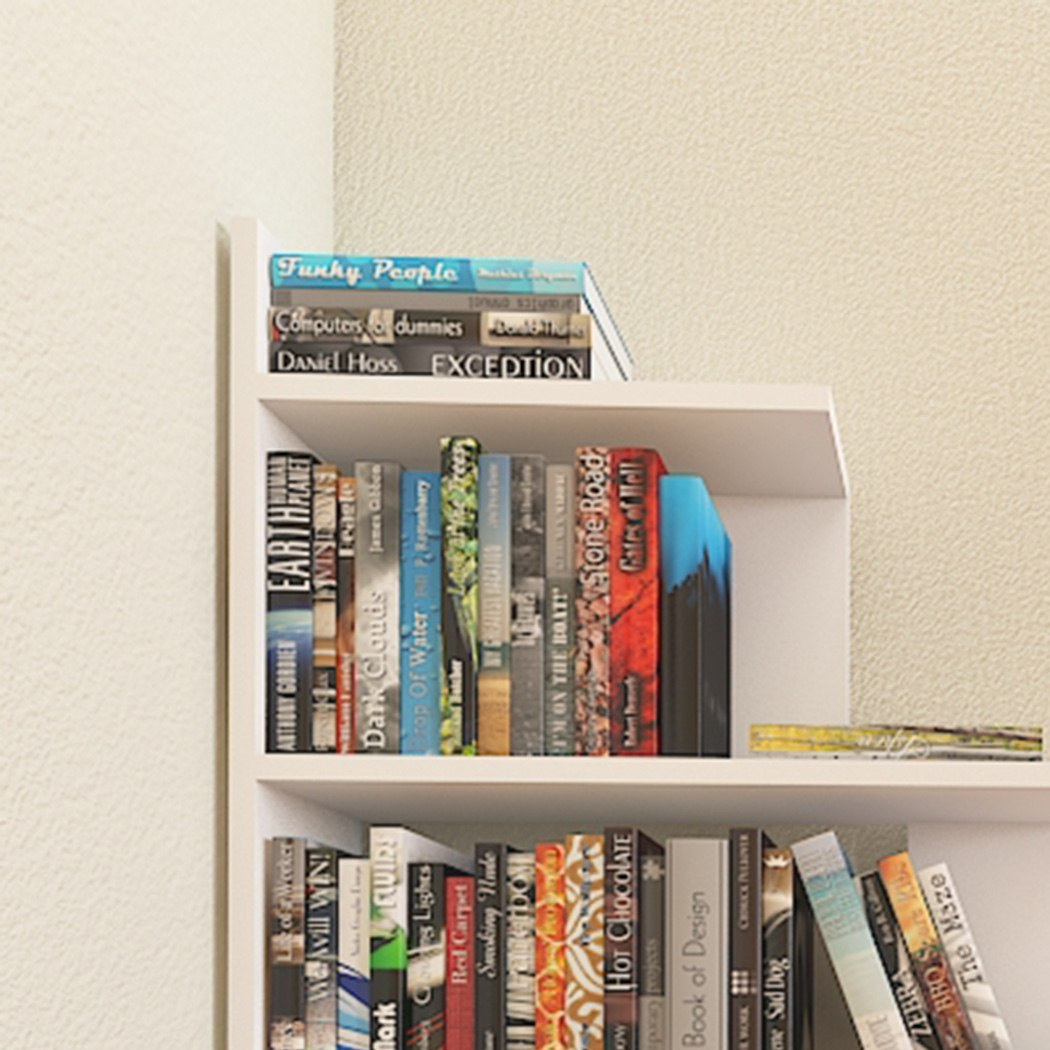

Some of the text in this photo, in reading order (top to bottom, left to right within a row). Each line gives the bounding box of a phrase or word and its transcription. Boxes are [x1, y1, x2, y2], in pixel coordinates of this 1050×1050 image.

[277, 256, 363, 287] Funky
[372, 258, 459, 285] People
[274, 311, 464, 337] Computers dummies
[268, 507, 311, 592] EARTH
[579, 454, 606, 586] Stone Road
[409, 610, 428, 667] Water
[551, 650, 568, 685] THE
[362, 590, 387, 749] Dark Clouds
[412, 864, 434, 920] Lights
[604, 833, 634, 941] CHOCOLATE
[450, 884, 472, 984] Red Carpet
[681, 891, 710, 957] Design
[930, 872, 984, 991] The Maze
[605, 951, 637, 991] HOT
[681, 963, 706, 988] of
[681, 996, 706, 1048] Book
[891, 967, 932, 1038] ZEBRA
